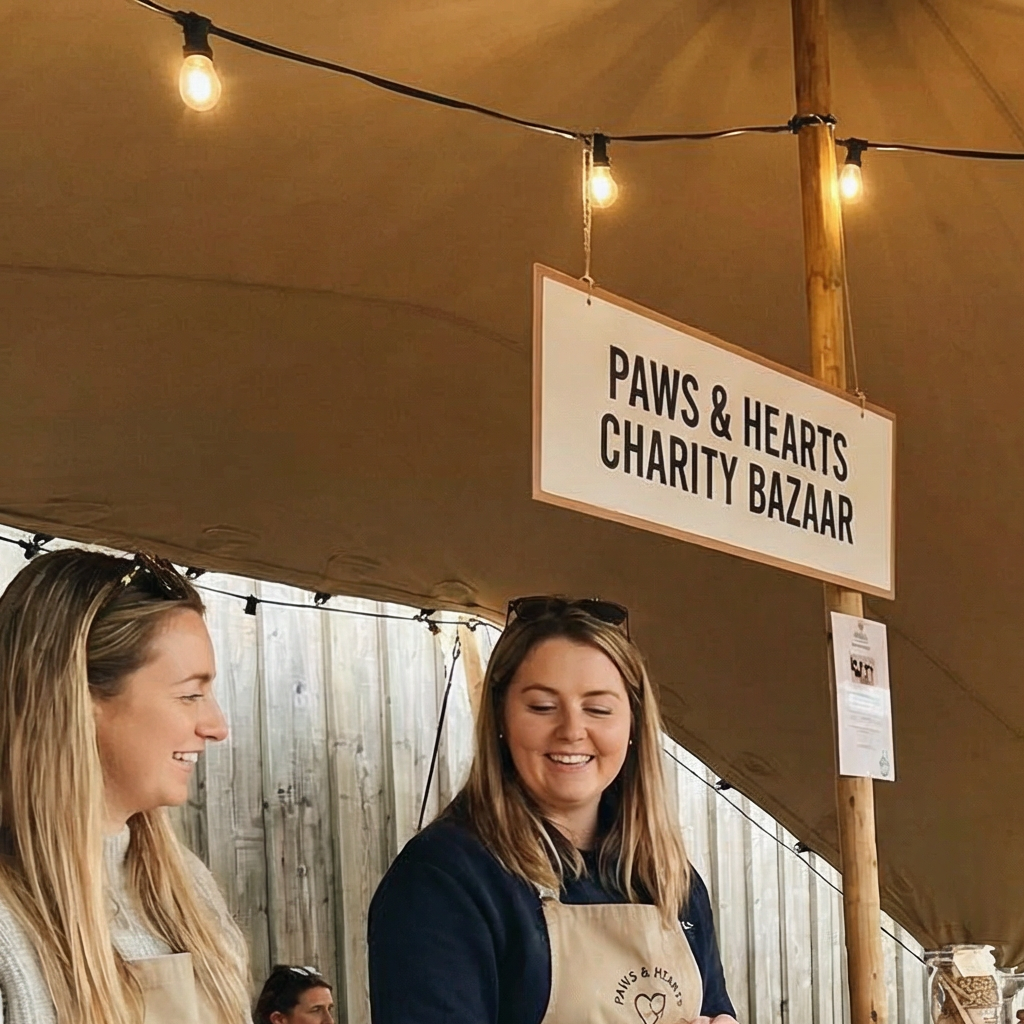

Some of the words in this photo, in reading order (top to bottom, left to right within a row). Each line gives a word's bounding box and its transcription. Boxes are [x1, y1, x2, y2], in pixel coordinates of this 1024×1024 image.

[600, 413, 738, 505] CHARITY
[749, 463, 854, 545] BAZAAR
[609, 344, 700, 429] PAWS
[710, 384, 733, 442] &
[743, 396, 849, 482] HEARTS
[641, 966, 650, 978] &
